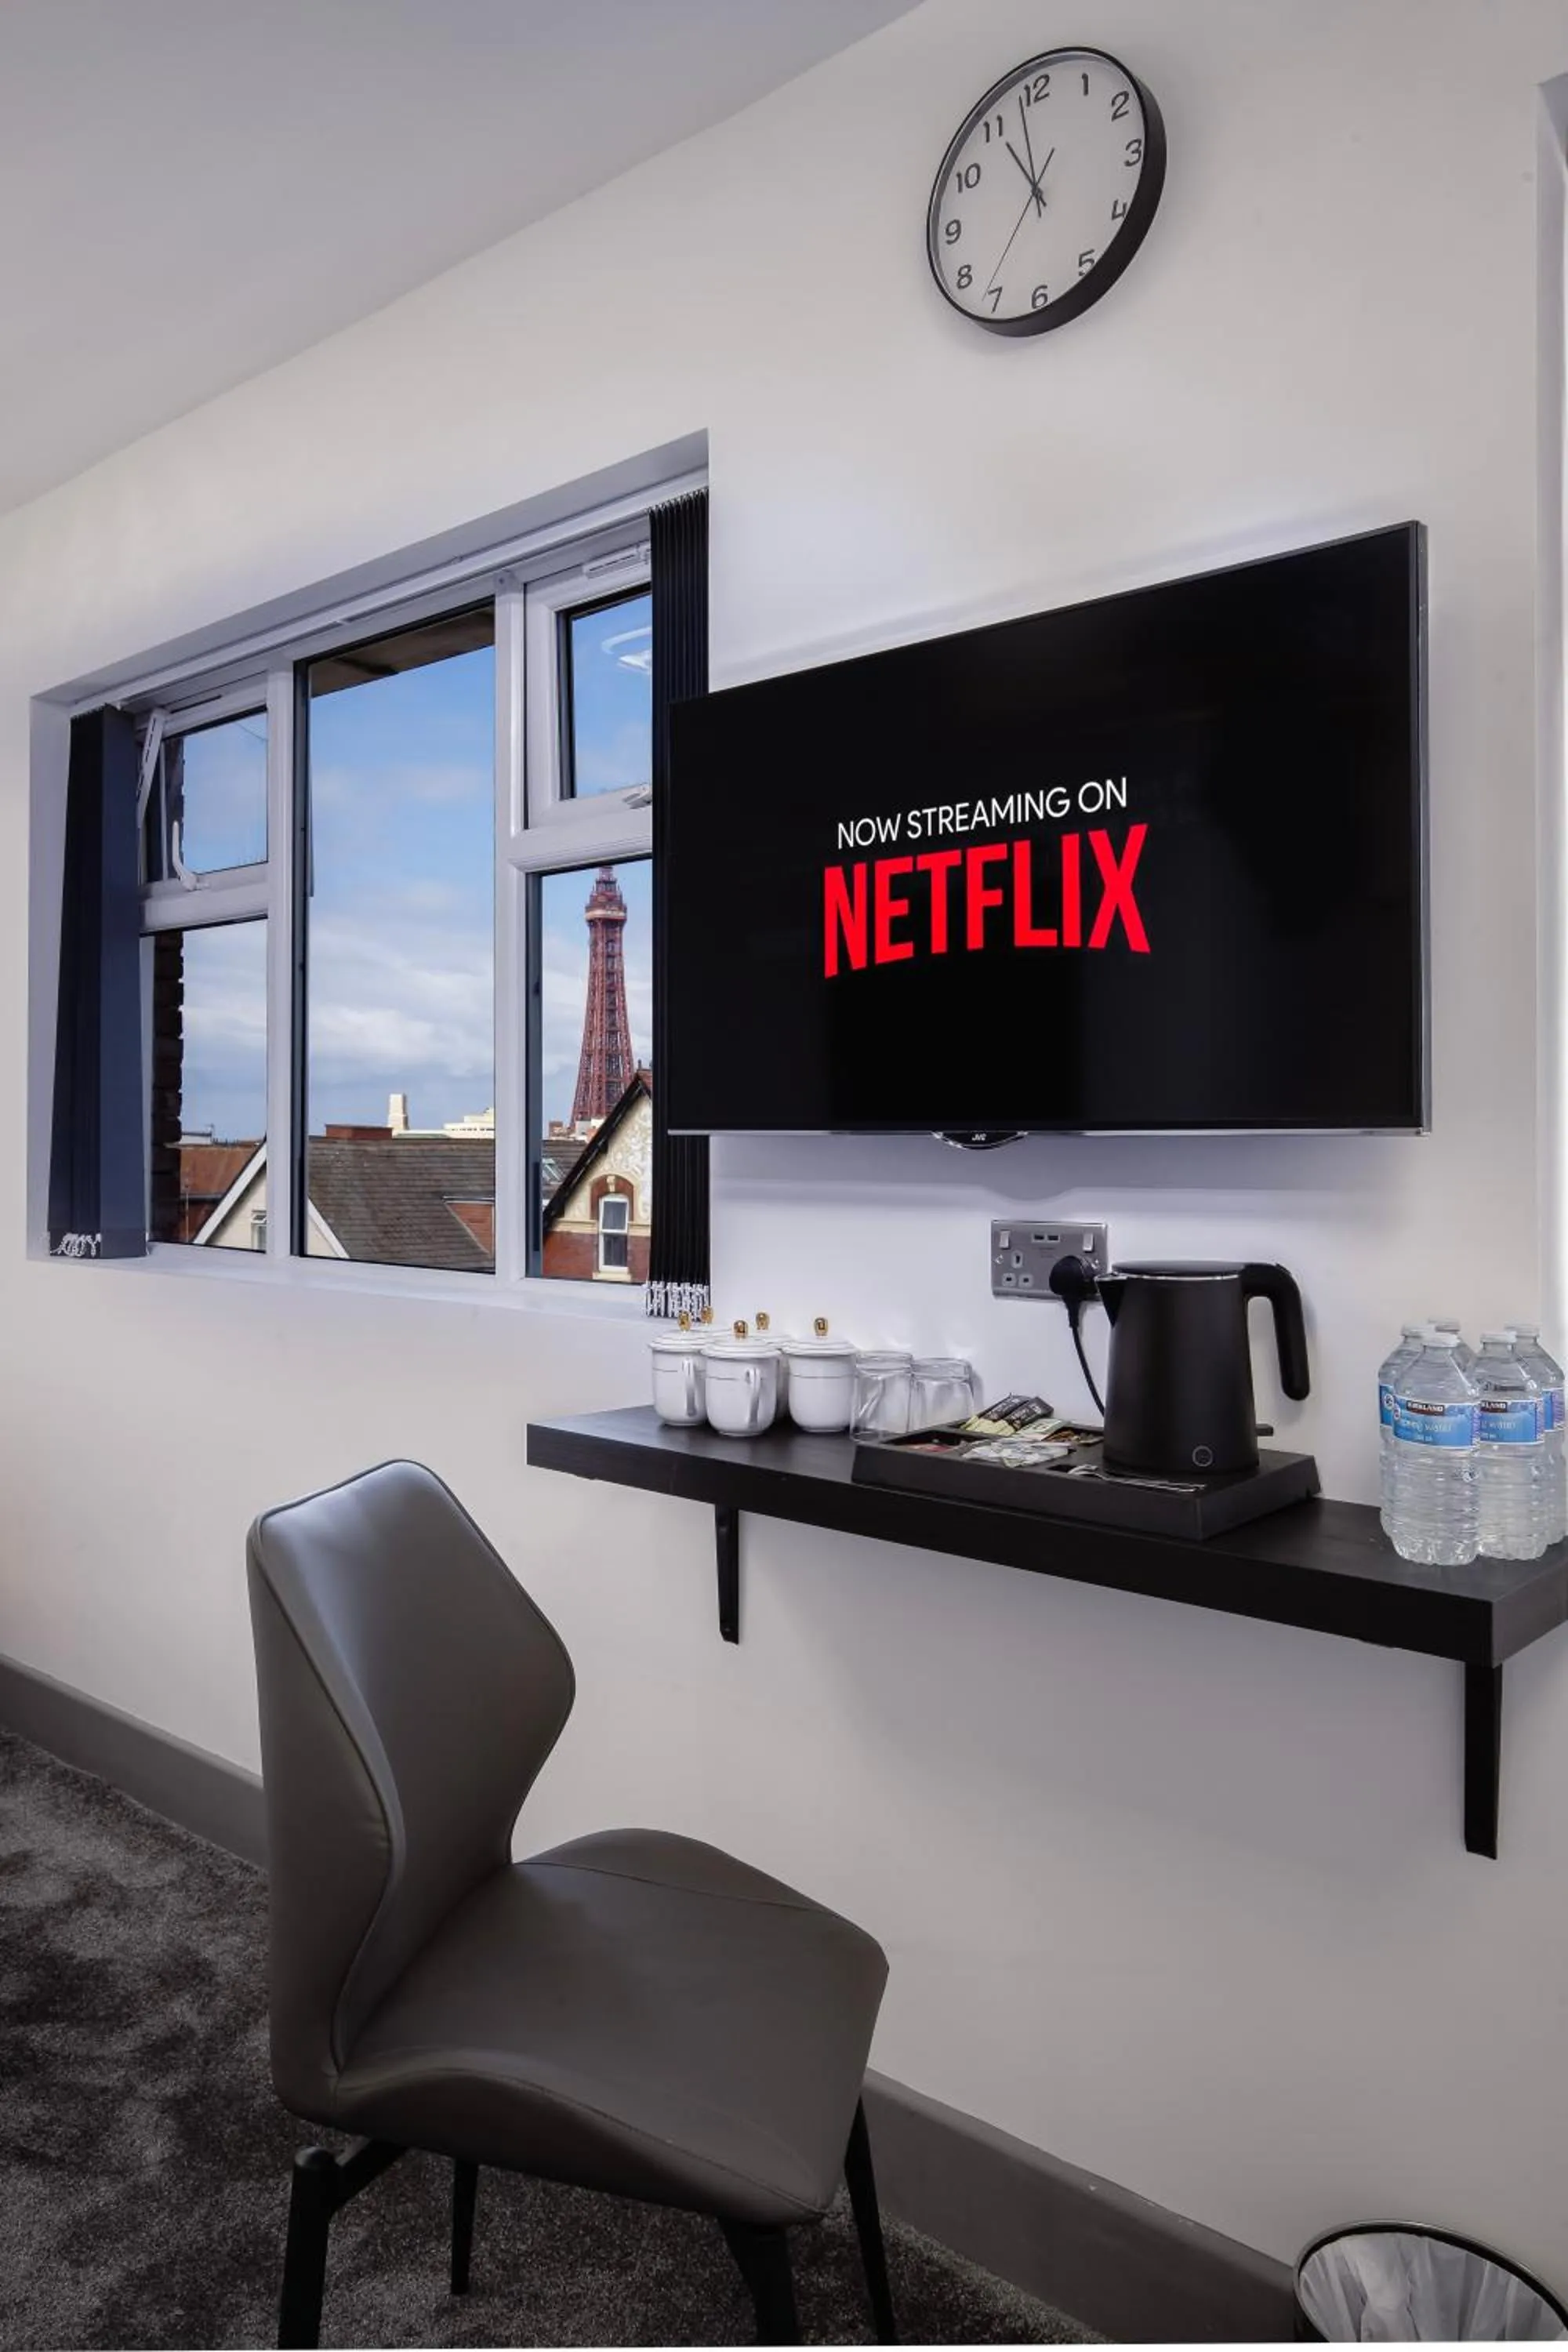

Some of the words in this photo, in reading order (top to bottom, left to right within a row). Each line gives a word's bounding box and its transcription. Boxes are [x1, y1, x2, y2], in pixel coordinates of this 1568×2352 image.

[1023, 73, 1051, 107] 12
[1081, 72, 1090, 96] 1
[1110, 89, 1131, 122] 2
[982, 114, 1004, 143] 11
[1123, 138, 1142, 168] 3
[956, 162, 982, 194] 10
[944, 218, 963, 245] 9
[956, 263, 974, 290] 8
[1077, 248, 1096, 277] 5
[986, 285, 1004, 314] 7
[1030, 284, 1050, 310] 6
[837, 812, 902, 850] NOW
[906, 786, 1071, 839] STREAMING
[1078, 776, 1127, 814] ON
[824, 823, 1151, 979] NETFLIX
